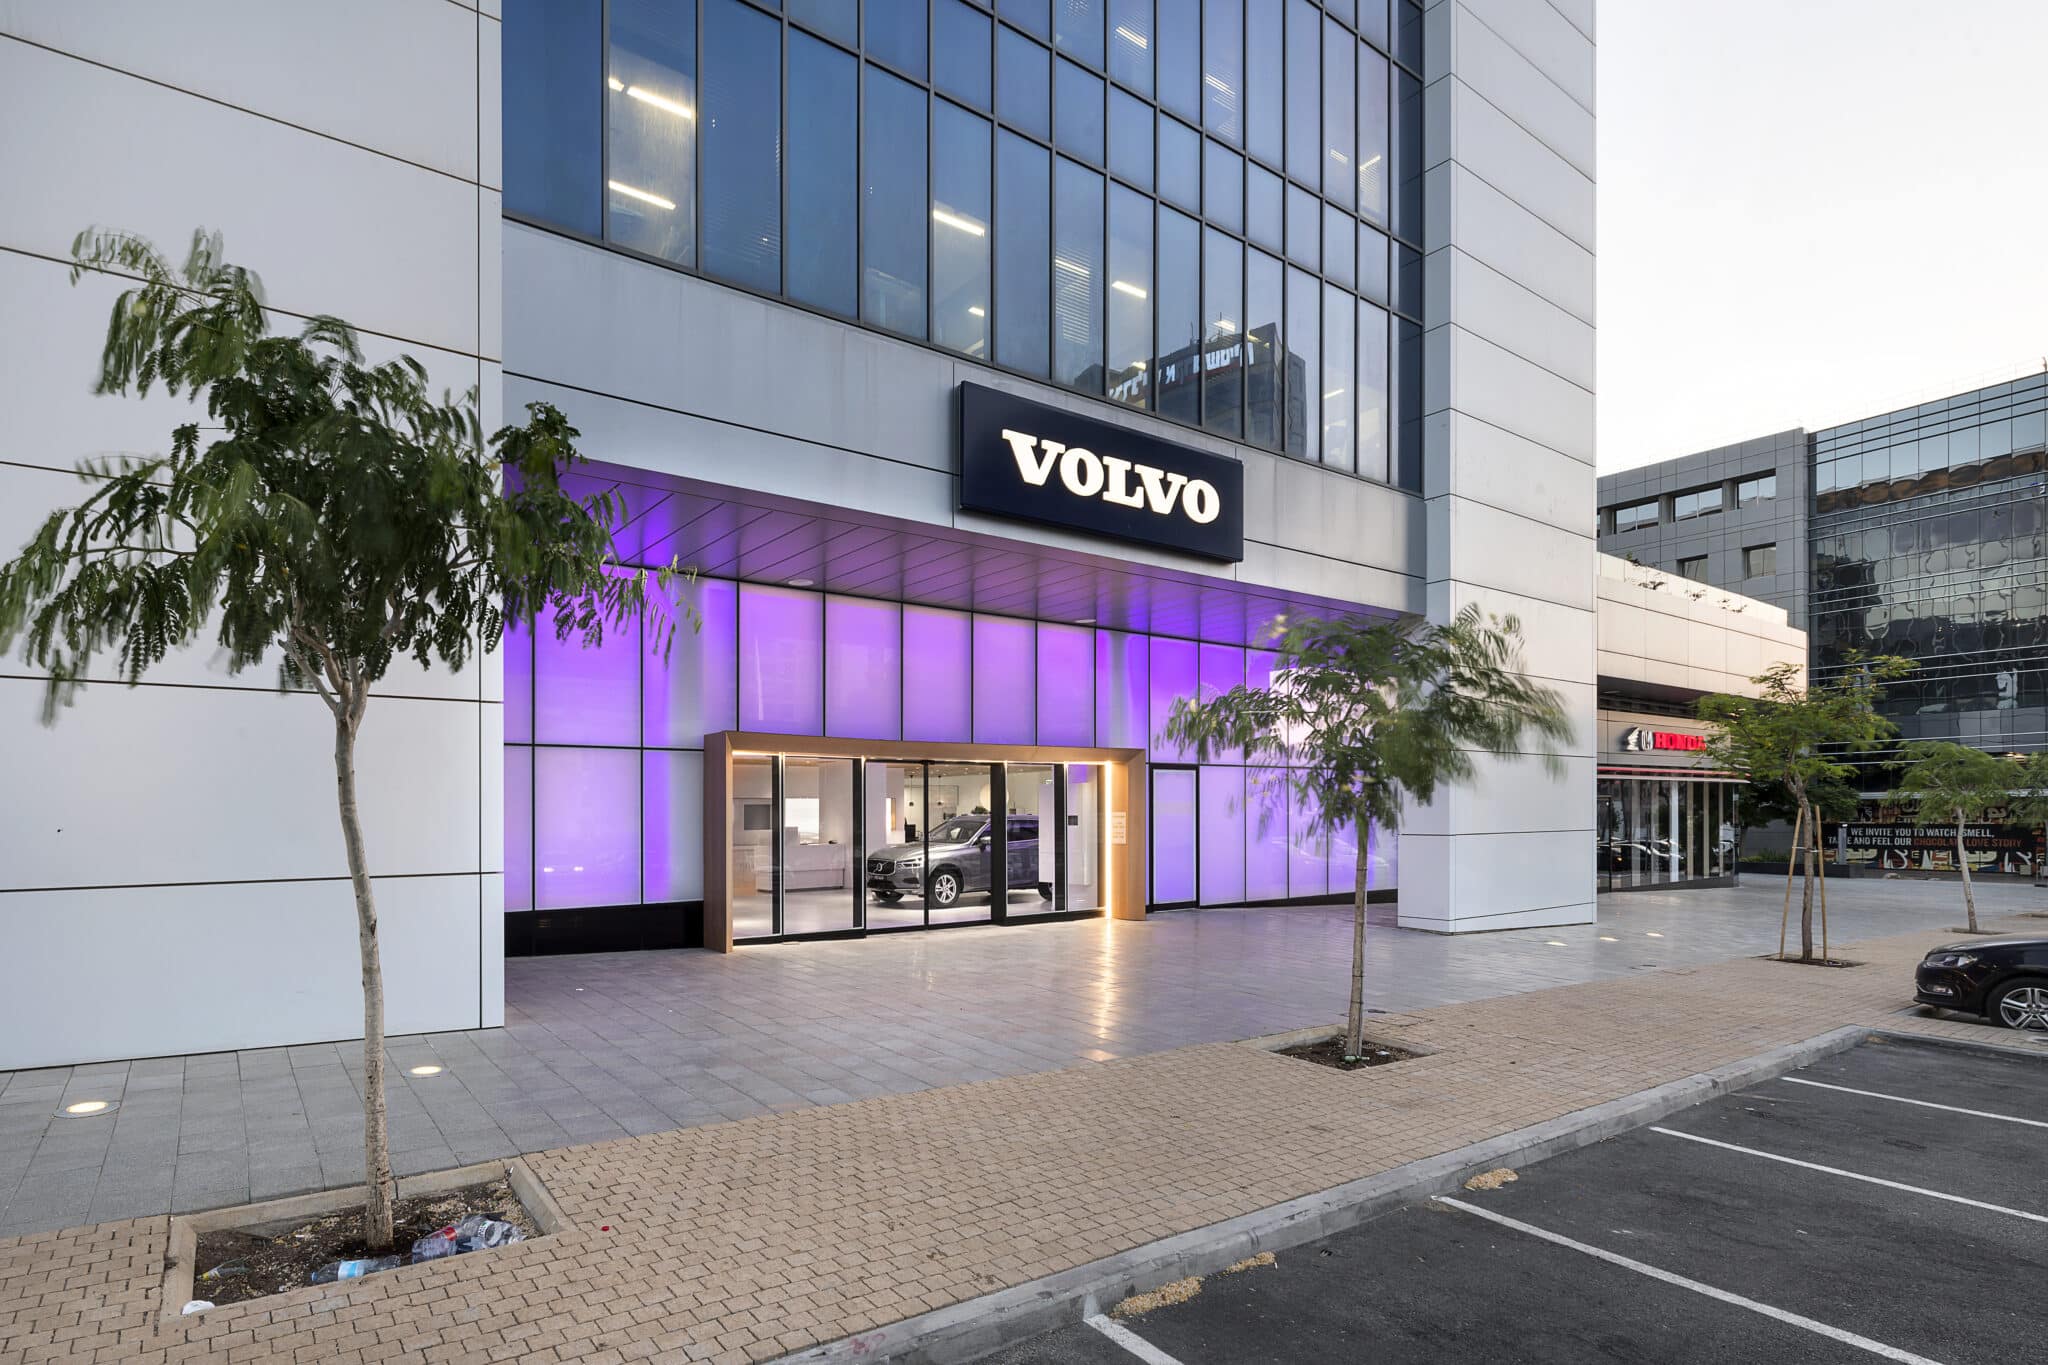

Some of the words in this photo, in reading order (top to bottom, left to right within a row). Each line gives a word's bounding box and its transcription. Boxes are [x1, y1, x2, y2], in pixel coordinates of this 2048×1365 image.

[1002, 429, 1220, 524] VOLVO
[1654, 732, 1706, 751] HONDA
[1851, 827, 1864, 836] WE
[1866, 827, 1893, 836] INVITE
[1895, 828, 1912, 836] YOU
[1914, 828, 1925, 837] TO
[1828, 836, 1853, 845] TAE
[1854, 837, 1871, 845] AND
[1872, 837, 1893, 846] FEEL
[1894, 837, 1912, 846] OUR
[1913, 838, 1959, 847] CHOCOLAT
[1966, 838, 1990, 847] LOVE
[1991, 838, 2022, 848] STORY
